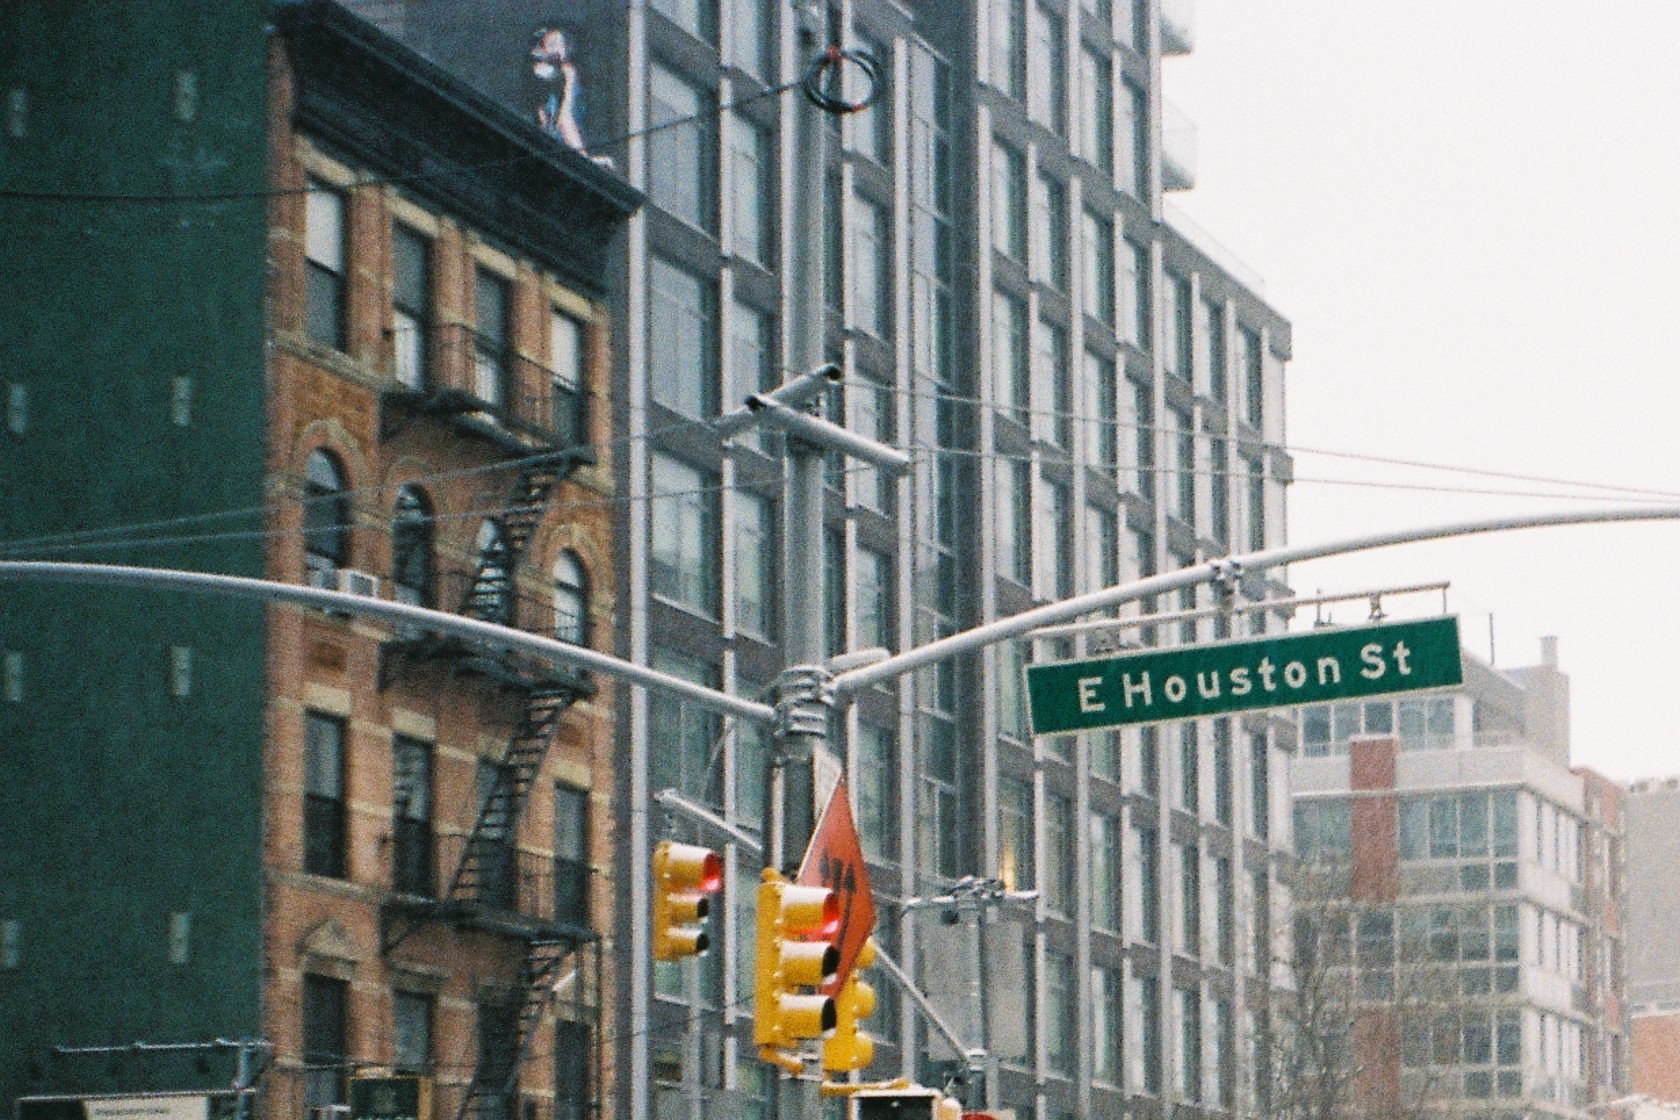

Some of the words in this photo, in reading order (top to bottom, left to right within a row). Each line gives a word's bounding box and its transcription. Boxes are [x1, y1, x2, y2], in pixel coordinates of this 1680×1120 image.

[1076, 676, 1106, 714] E
[1122, 655, 1342, 709] Houston
[1359, 639, 1413, 680] St
